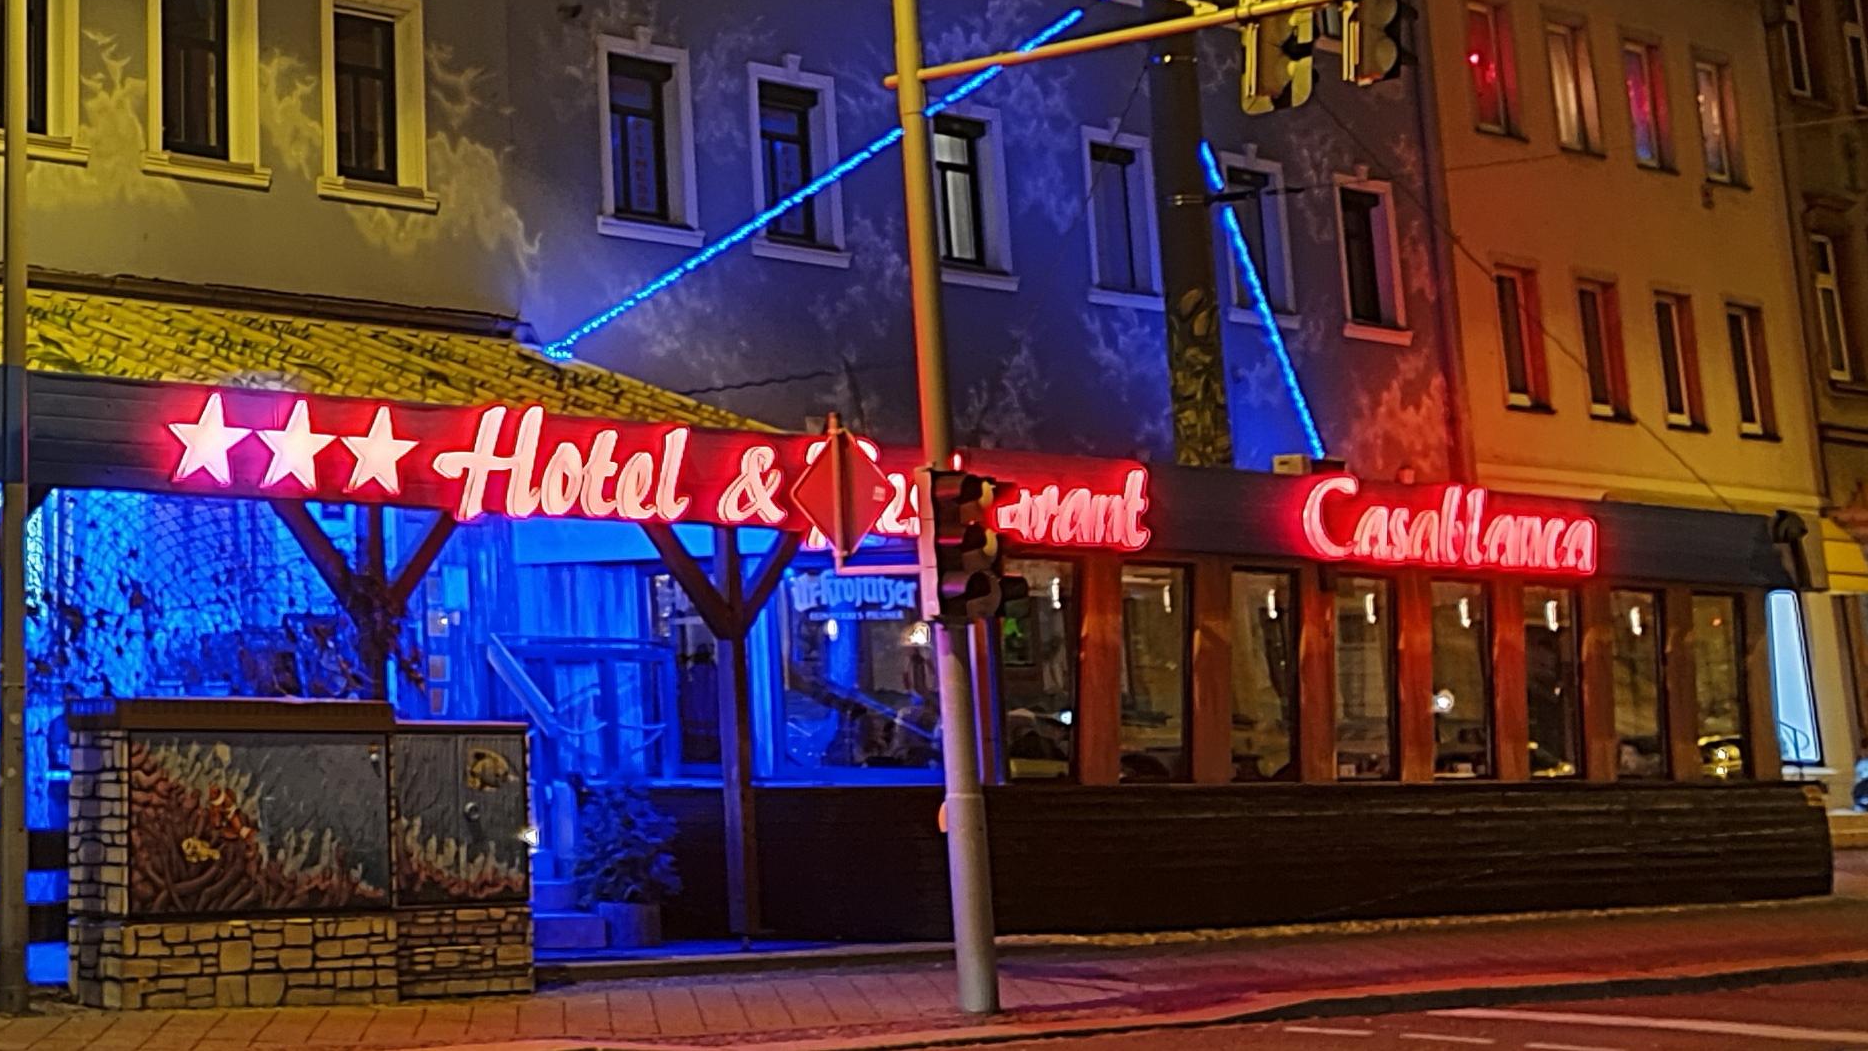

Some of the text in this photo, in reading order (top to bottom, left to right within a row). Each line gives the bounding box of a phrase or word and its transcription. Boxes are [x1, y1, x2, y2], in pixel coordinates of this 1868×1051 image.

[432, 405, 693, 521] Hotel
[717, 445, 788, 524] &
[1303, 475, 1598, 575] Casablanca
